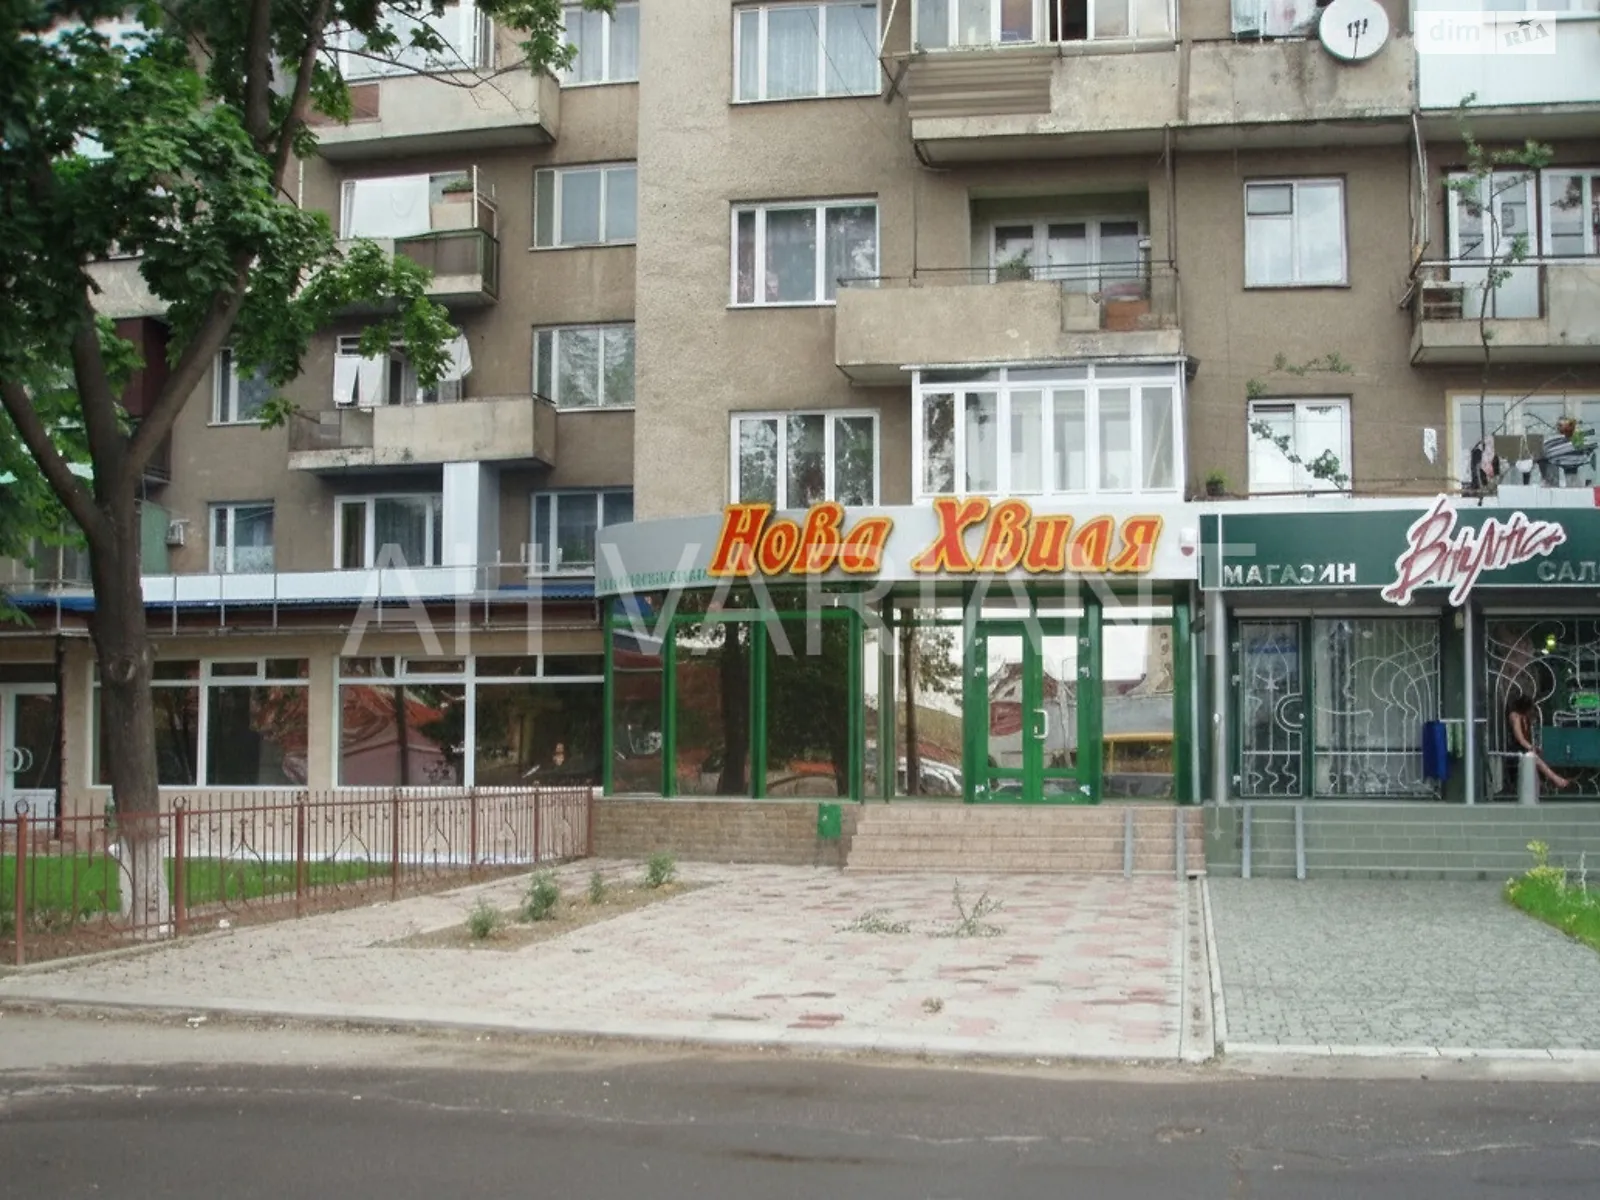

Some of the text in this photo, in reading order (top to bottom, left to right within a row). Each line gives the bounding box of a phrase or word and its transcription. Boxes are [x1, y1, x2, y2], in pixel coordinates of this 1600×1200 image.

[707, 496, 1164, 576] Нова Хвиля
[1224, 560, 1600, 585] МАГАЗИН САЛ
